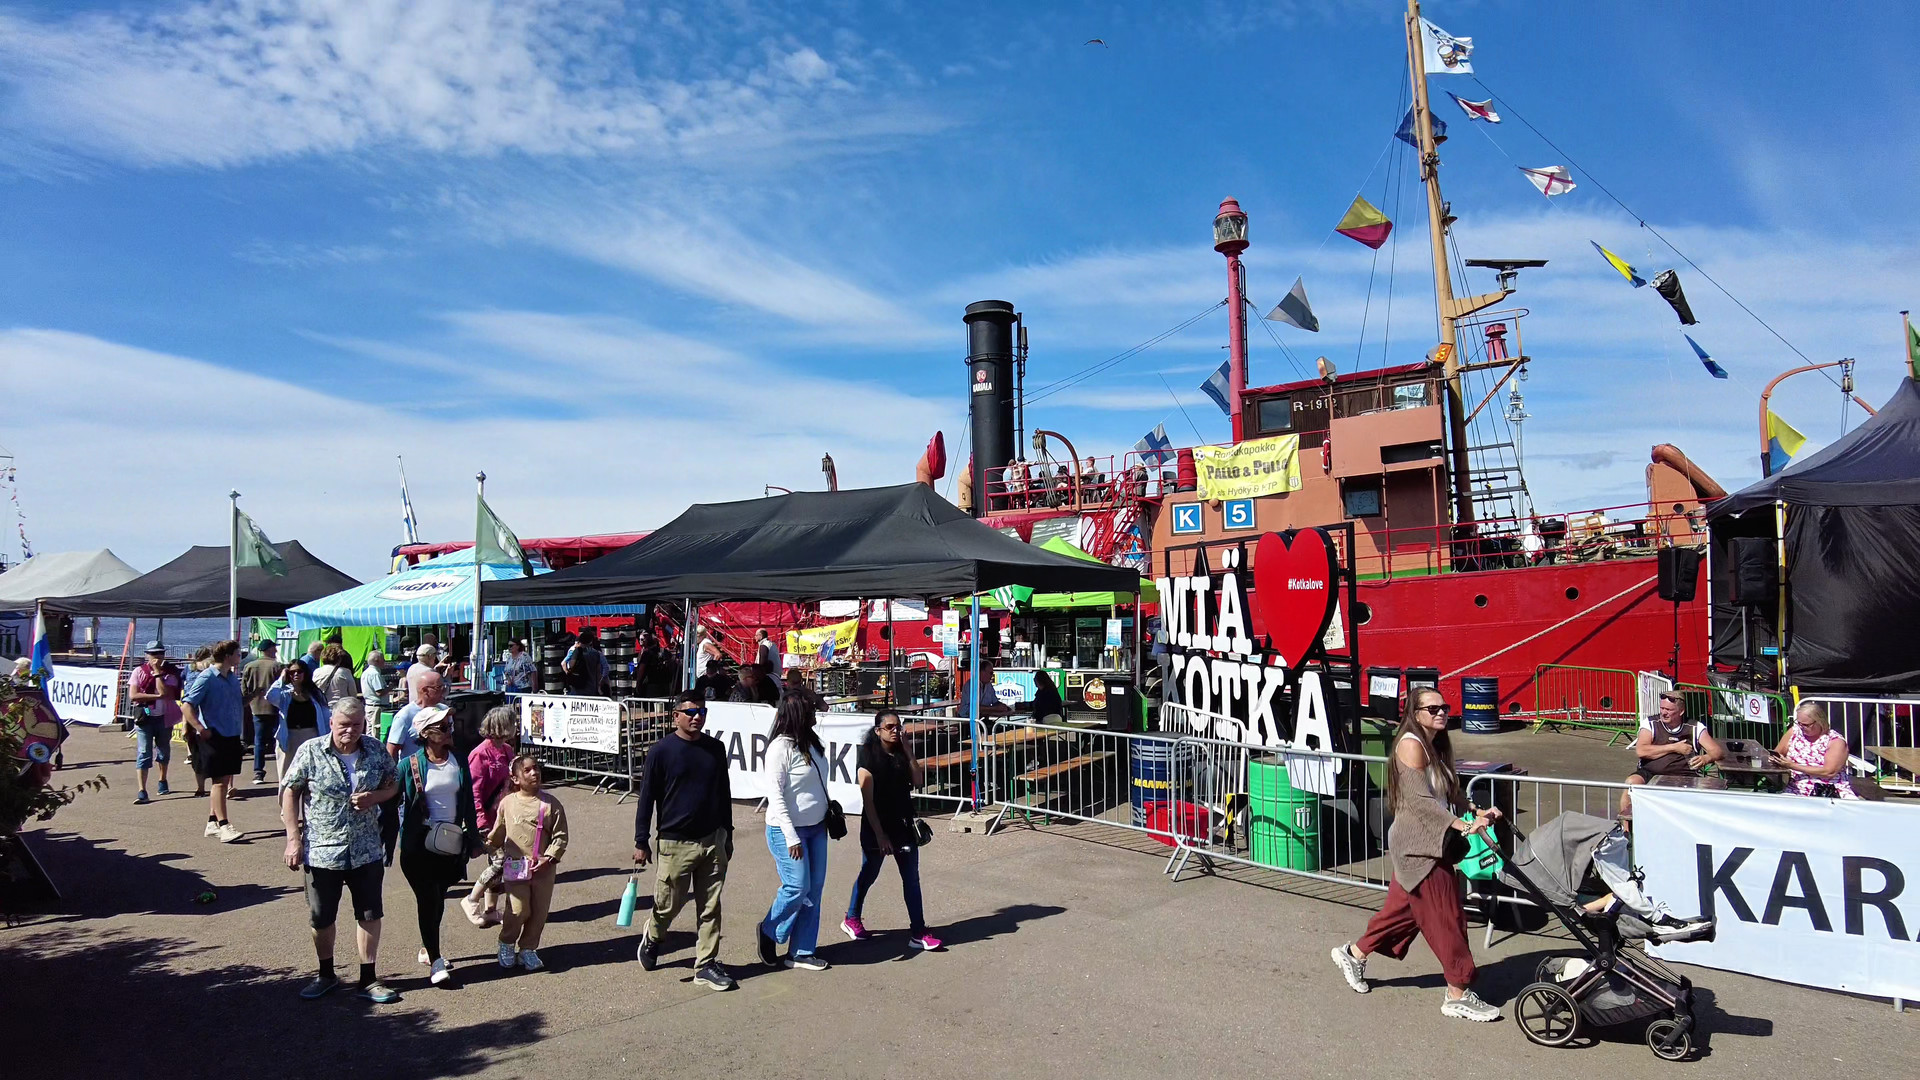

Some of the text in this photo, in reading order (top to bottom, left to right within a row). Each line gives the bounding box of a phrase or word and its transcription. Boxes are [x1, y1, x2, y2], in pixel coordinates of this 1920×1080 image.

[1243, 466, 1251, 477] &
[1227, 486, 1252, 497] Hyöky
[1179, 504, 1246, 527] K 5
[390, 581, 455, 592] ORIGINAL
[1288, 578, 1323, 590] #Kotkalove
[1156, 548, 1252, 655] MIÄ
[52, 681, 109, 708] KARAOKE
[1157, 653, 1342, 773] KOTKA
[1696, 843, 1920, 942] KAR
